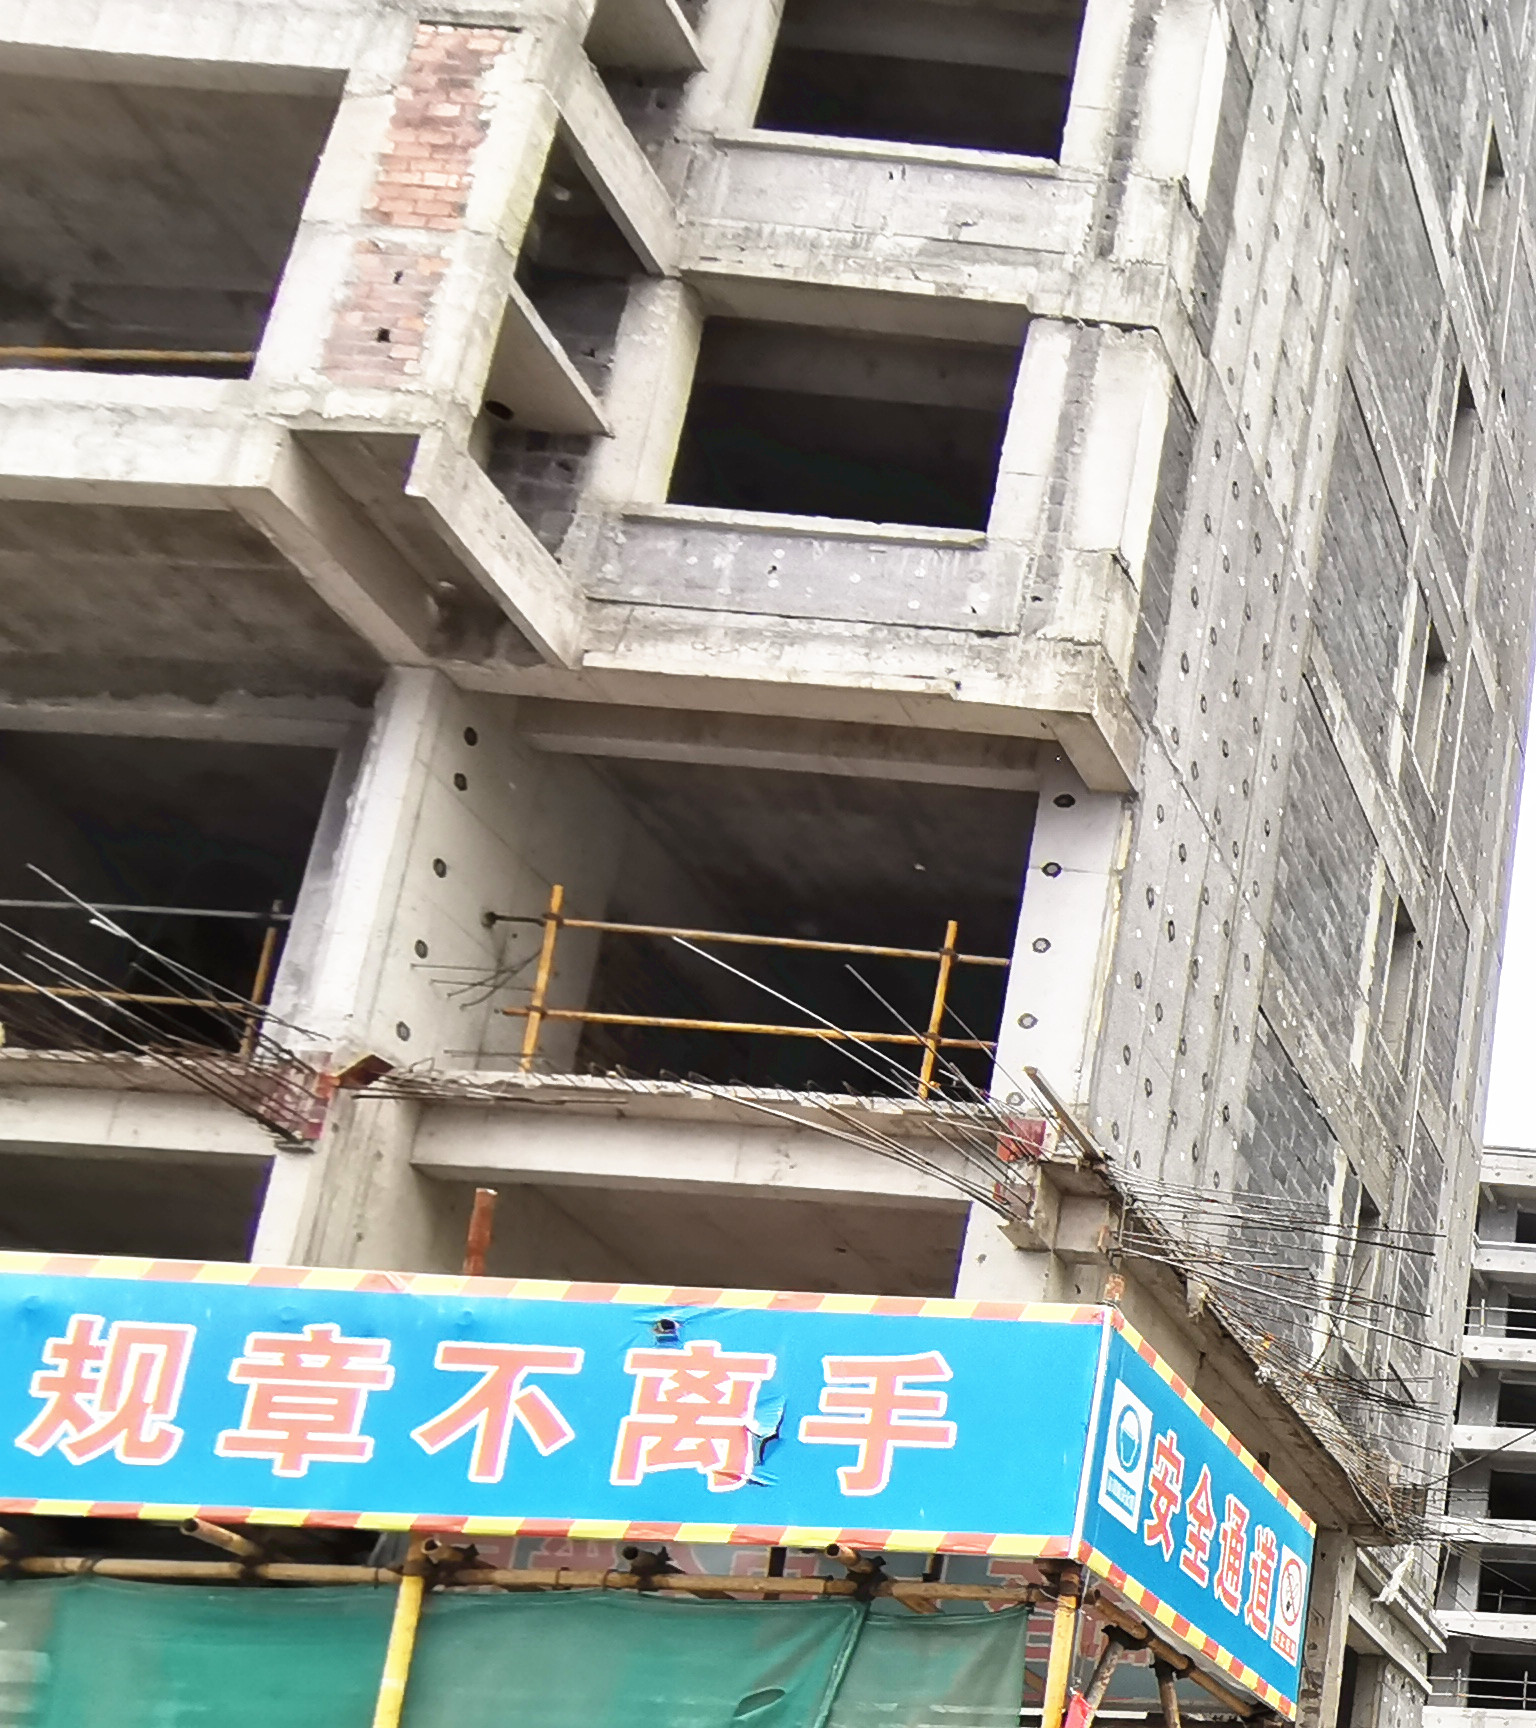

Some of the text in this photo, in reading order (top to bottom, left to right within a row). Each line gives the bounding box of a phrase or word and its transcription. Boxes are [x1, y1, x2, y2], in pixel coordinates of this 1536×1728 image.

[15, 1313, 956, 1497] 规章不离手
[1144, 1429, 1278, 1640] 安全通道
